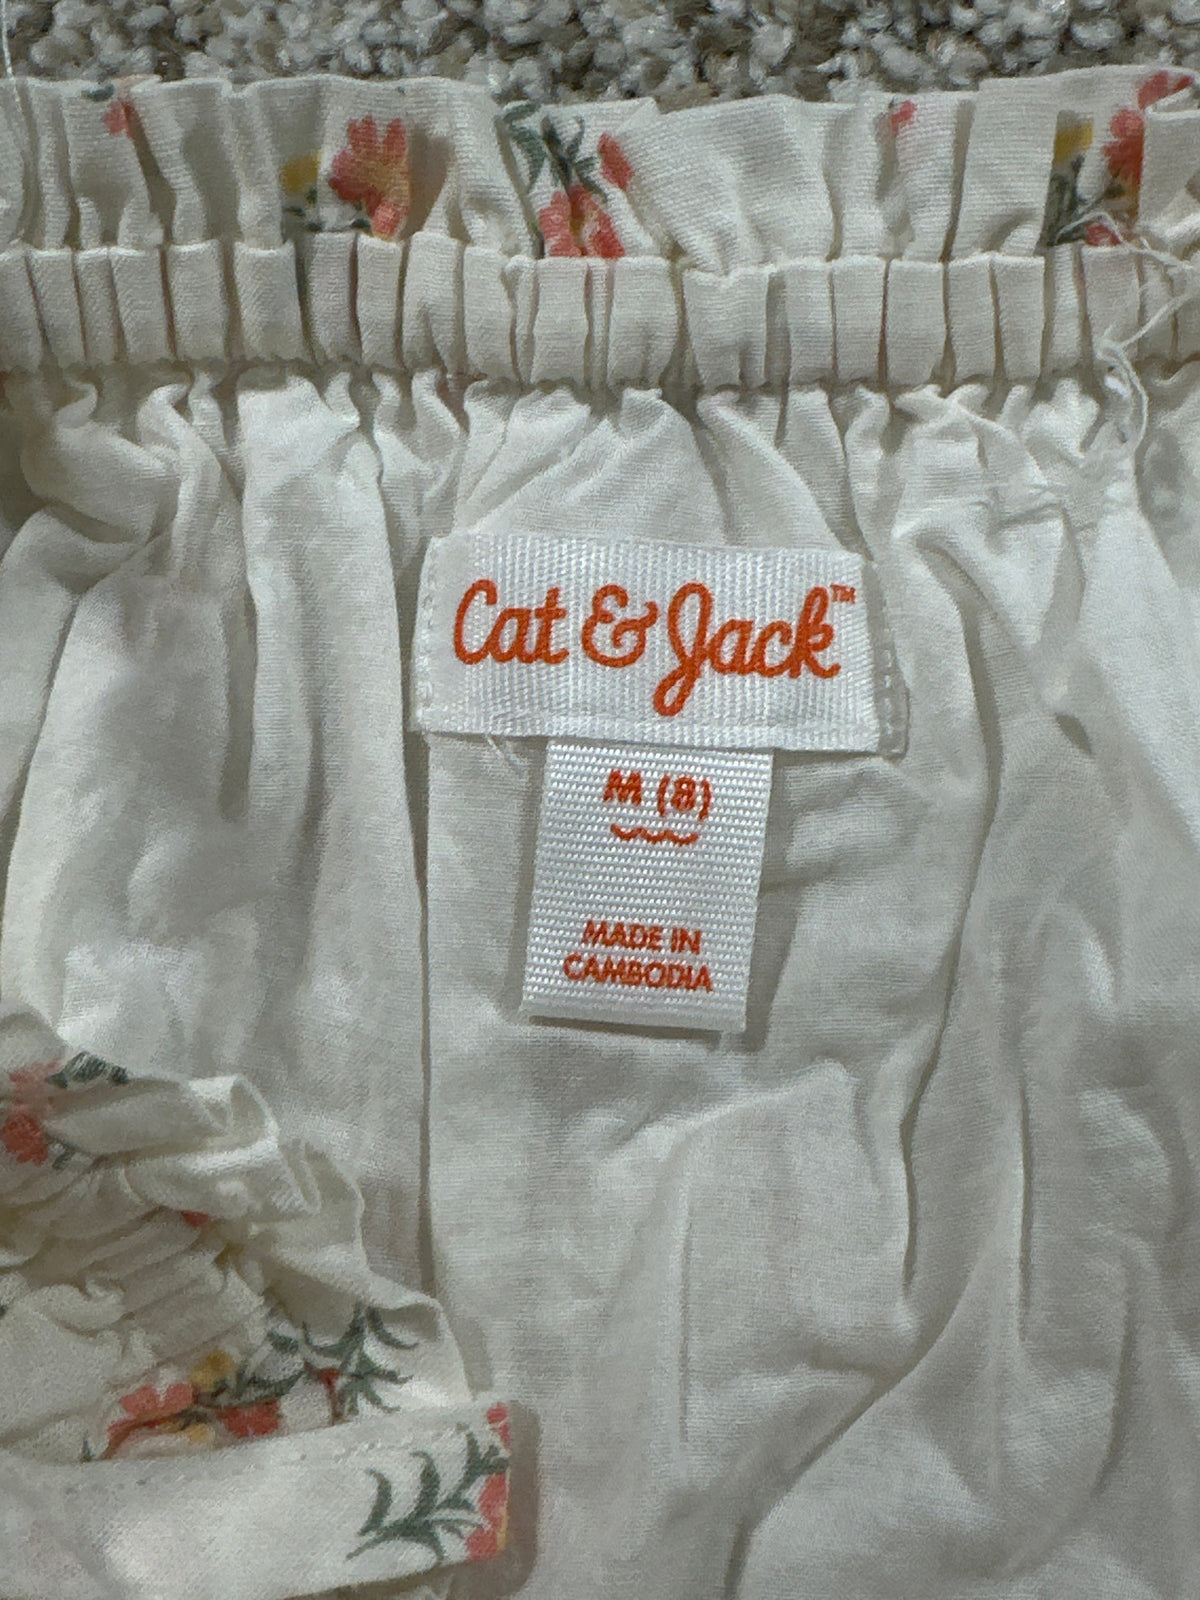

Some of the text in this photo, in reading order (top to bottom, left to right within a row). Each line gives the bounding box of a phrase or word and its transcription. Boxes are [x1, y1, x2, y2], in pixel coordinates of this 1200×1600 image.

[453, 579, 570, 665] Cat
[581, 584, 659, 669] &
[653, 582, 841, 717] Jack
[603, 769, 712, 821] M (8)
[582, 920, 701, 955] MADE IN
[563, 952, 713, 992] CAMBODIA
